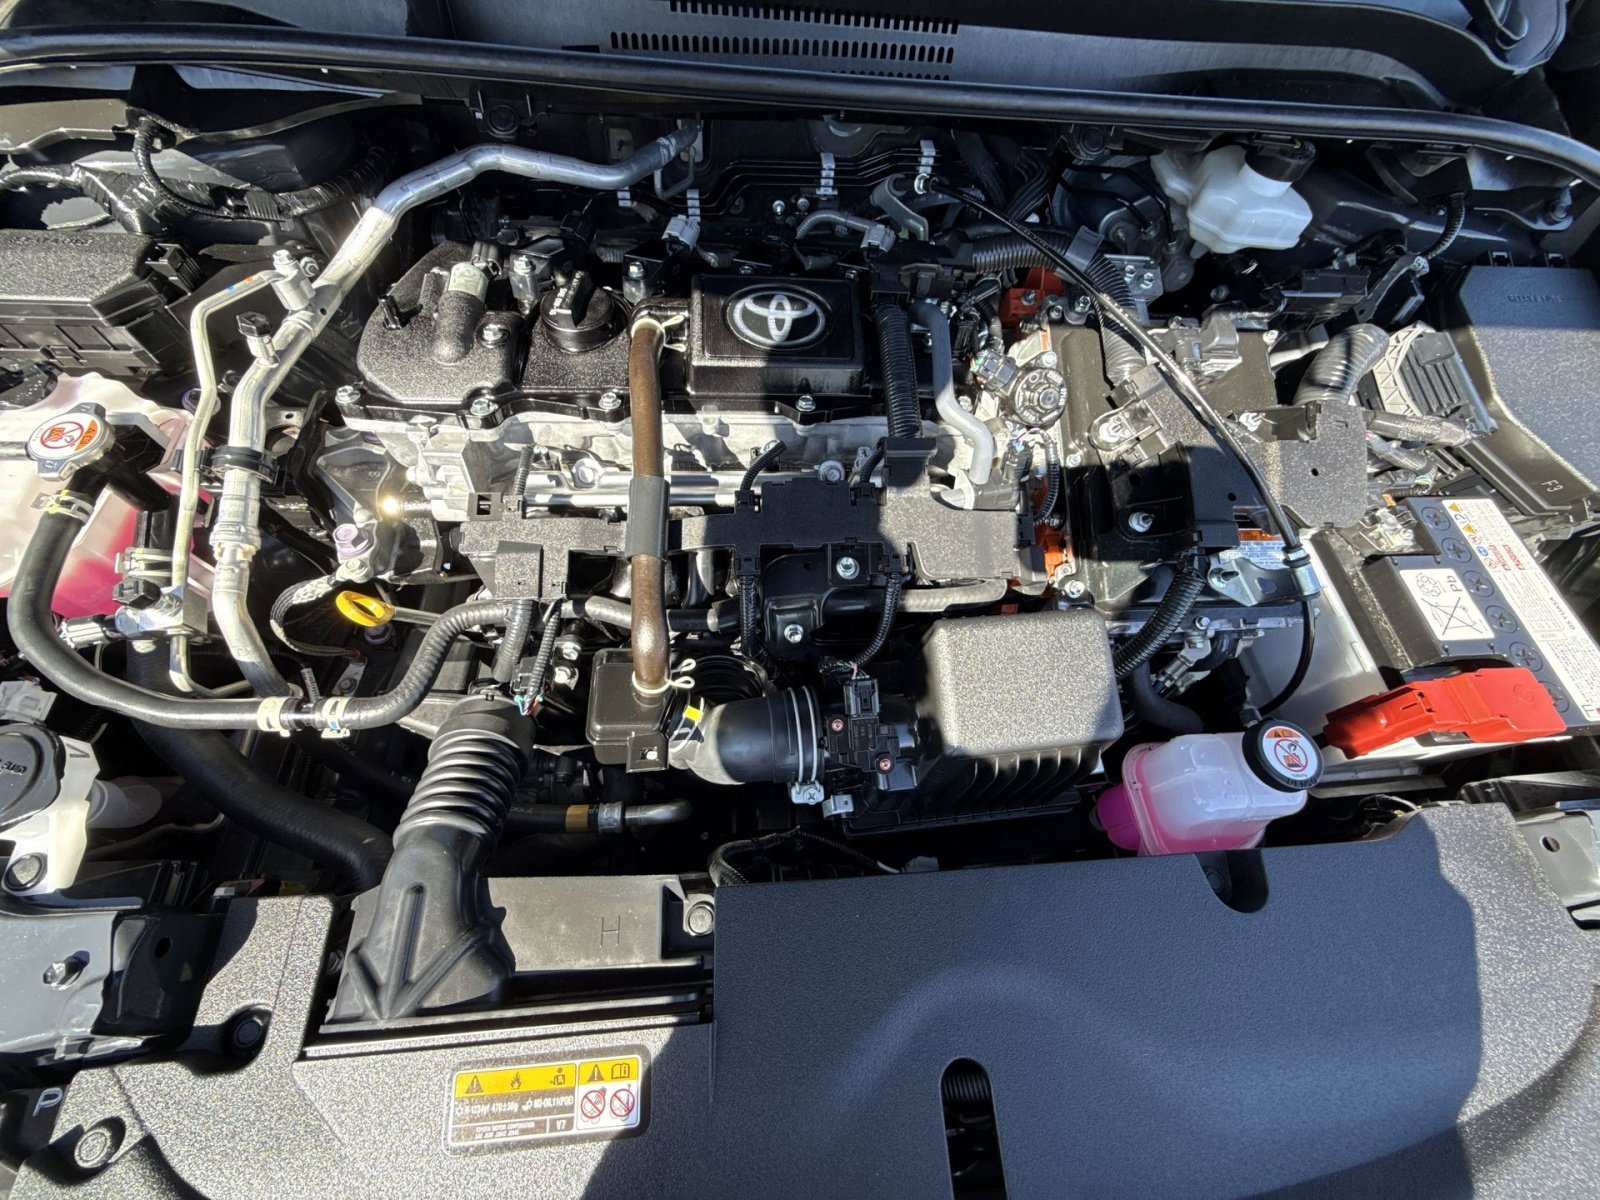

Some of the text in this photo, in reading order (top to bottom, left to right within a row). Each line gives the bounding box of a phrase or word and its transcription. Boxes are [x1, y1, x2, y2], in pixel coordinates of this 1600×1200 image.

[1540, 479, 1564, 493] F3
[1446, 575, 1463, 592] Pb
[1549, 596, 1569, 620] YUASA
[600, 915, 621, 946] H
[32, 1087, 63, 1118] P
[555, 1119, 567, 1131] V7
